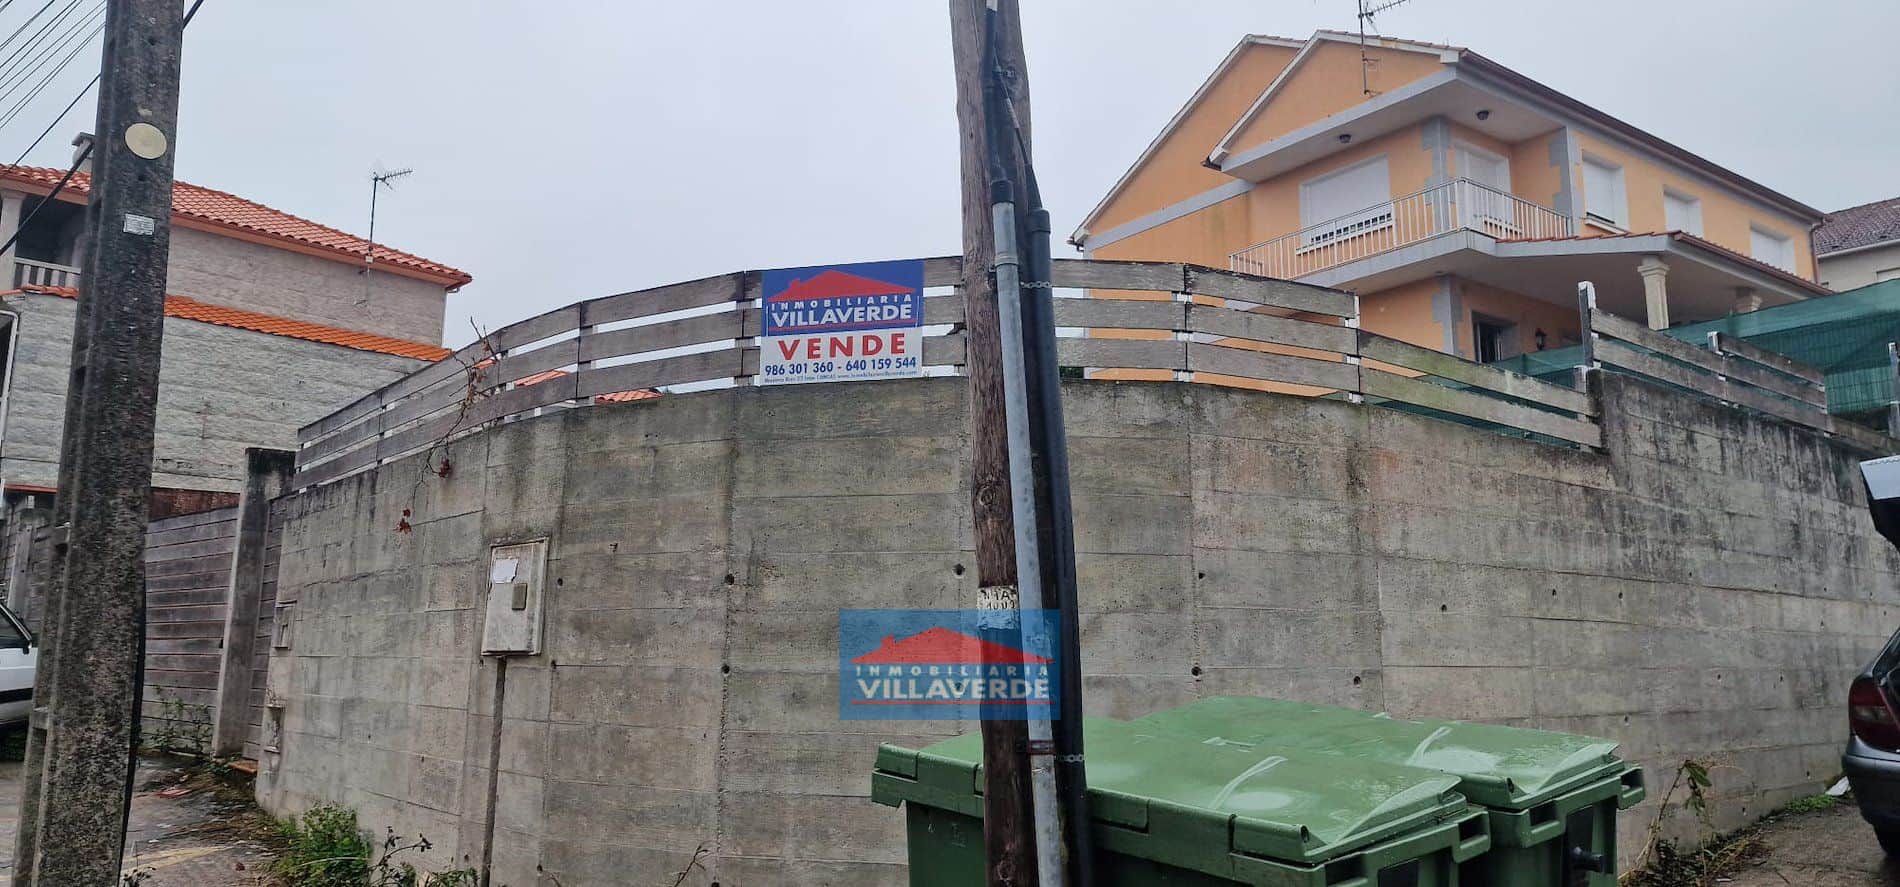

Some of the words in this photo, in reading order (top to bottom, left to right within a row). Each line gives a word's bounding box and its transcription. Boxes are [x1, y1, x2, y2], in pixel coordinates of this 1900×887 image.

[772, 295, 911, 310] INMOBILIARIA
[772, 304, 911, 327] VILLAVERDE
[778, 333, 904, 360] VENDE
[765, 364, 785, 376] 986
[789, 362, 808, 375] 301
[813, 361, 833, 373] 360
[846, 359, 866, 371] 640
[872, 358, 892, 370] 159
[895, 356, 916, 368] 544
